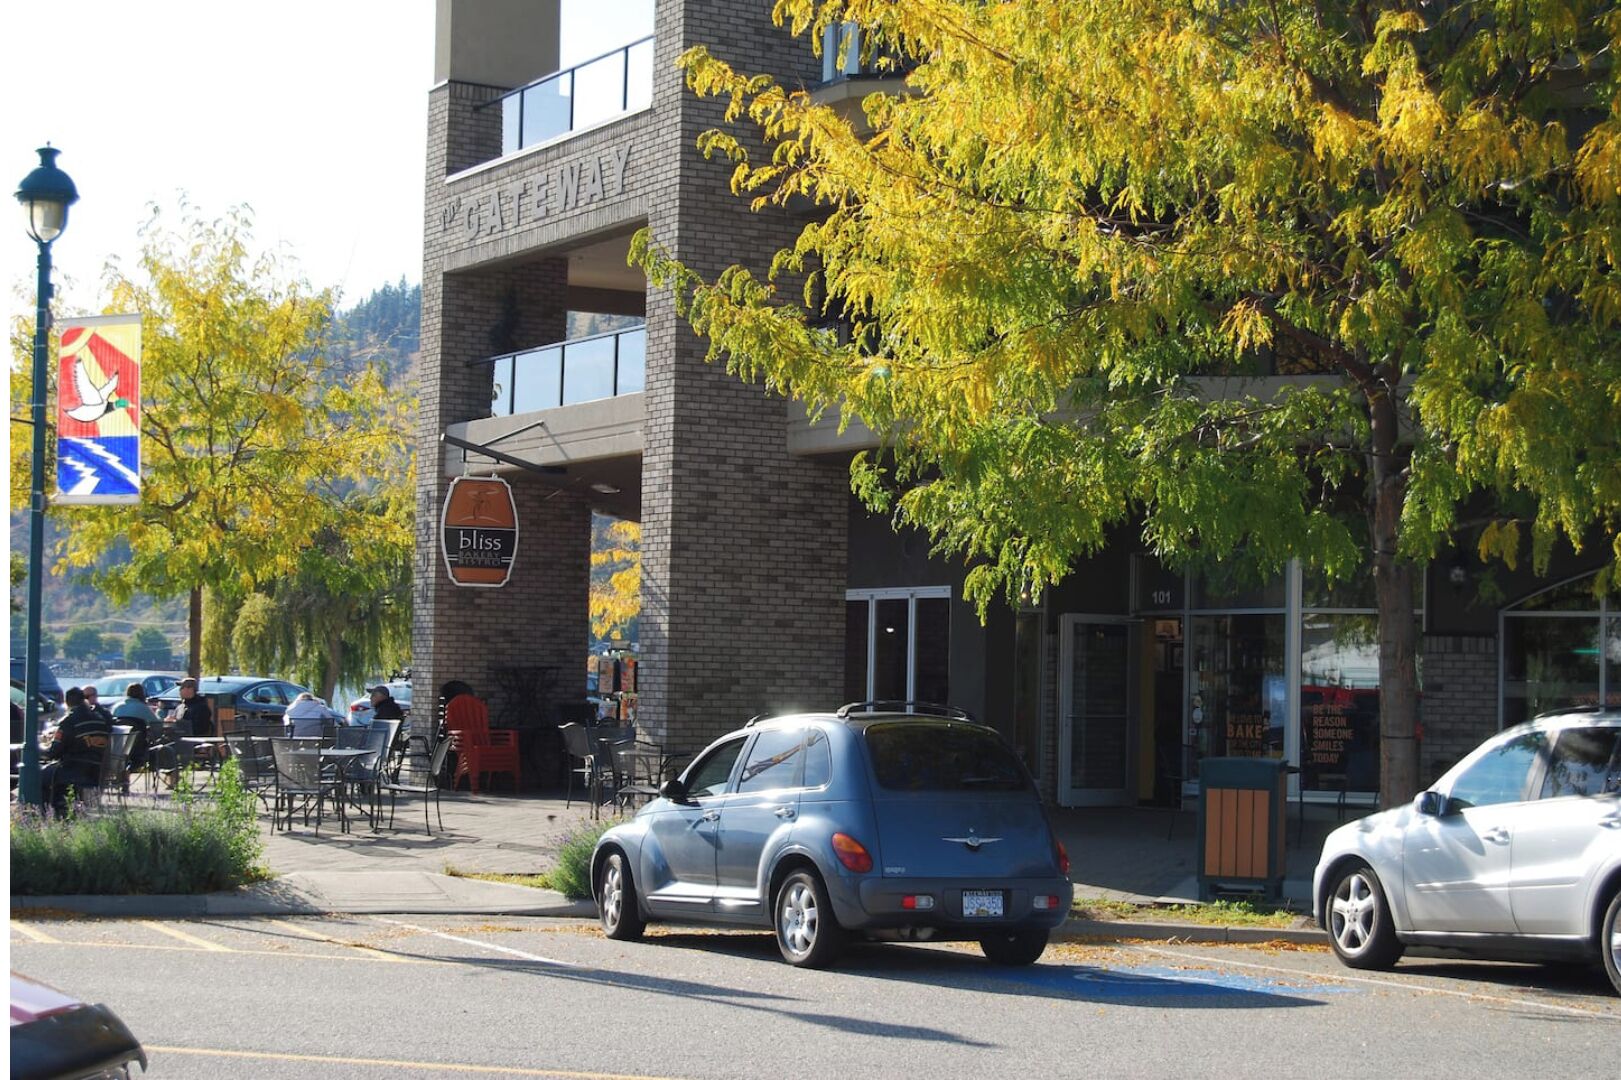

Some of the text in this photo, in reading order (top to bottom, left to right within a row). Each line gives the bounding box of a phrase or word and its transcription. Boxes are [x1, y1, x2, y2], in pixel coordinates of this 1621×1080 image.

[463, 142, 633, 240] GATEWAY
[459, 529, 502, 551] bliss
[1151, 590, 1171, 604] 101
[1312, 704, 1344, 715] BE THE
[1312, 716, 1347, 727] REASON
[1227, 724, 1263, 739] BAKE
[1312, 728, 1355, 740] SOMEONE
[1312, 740, 1344, 751] SMILES
[1312, 752, 1340, 764] TODAY
